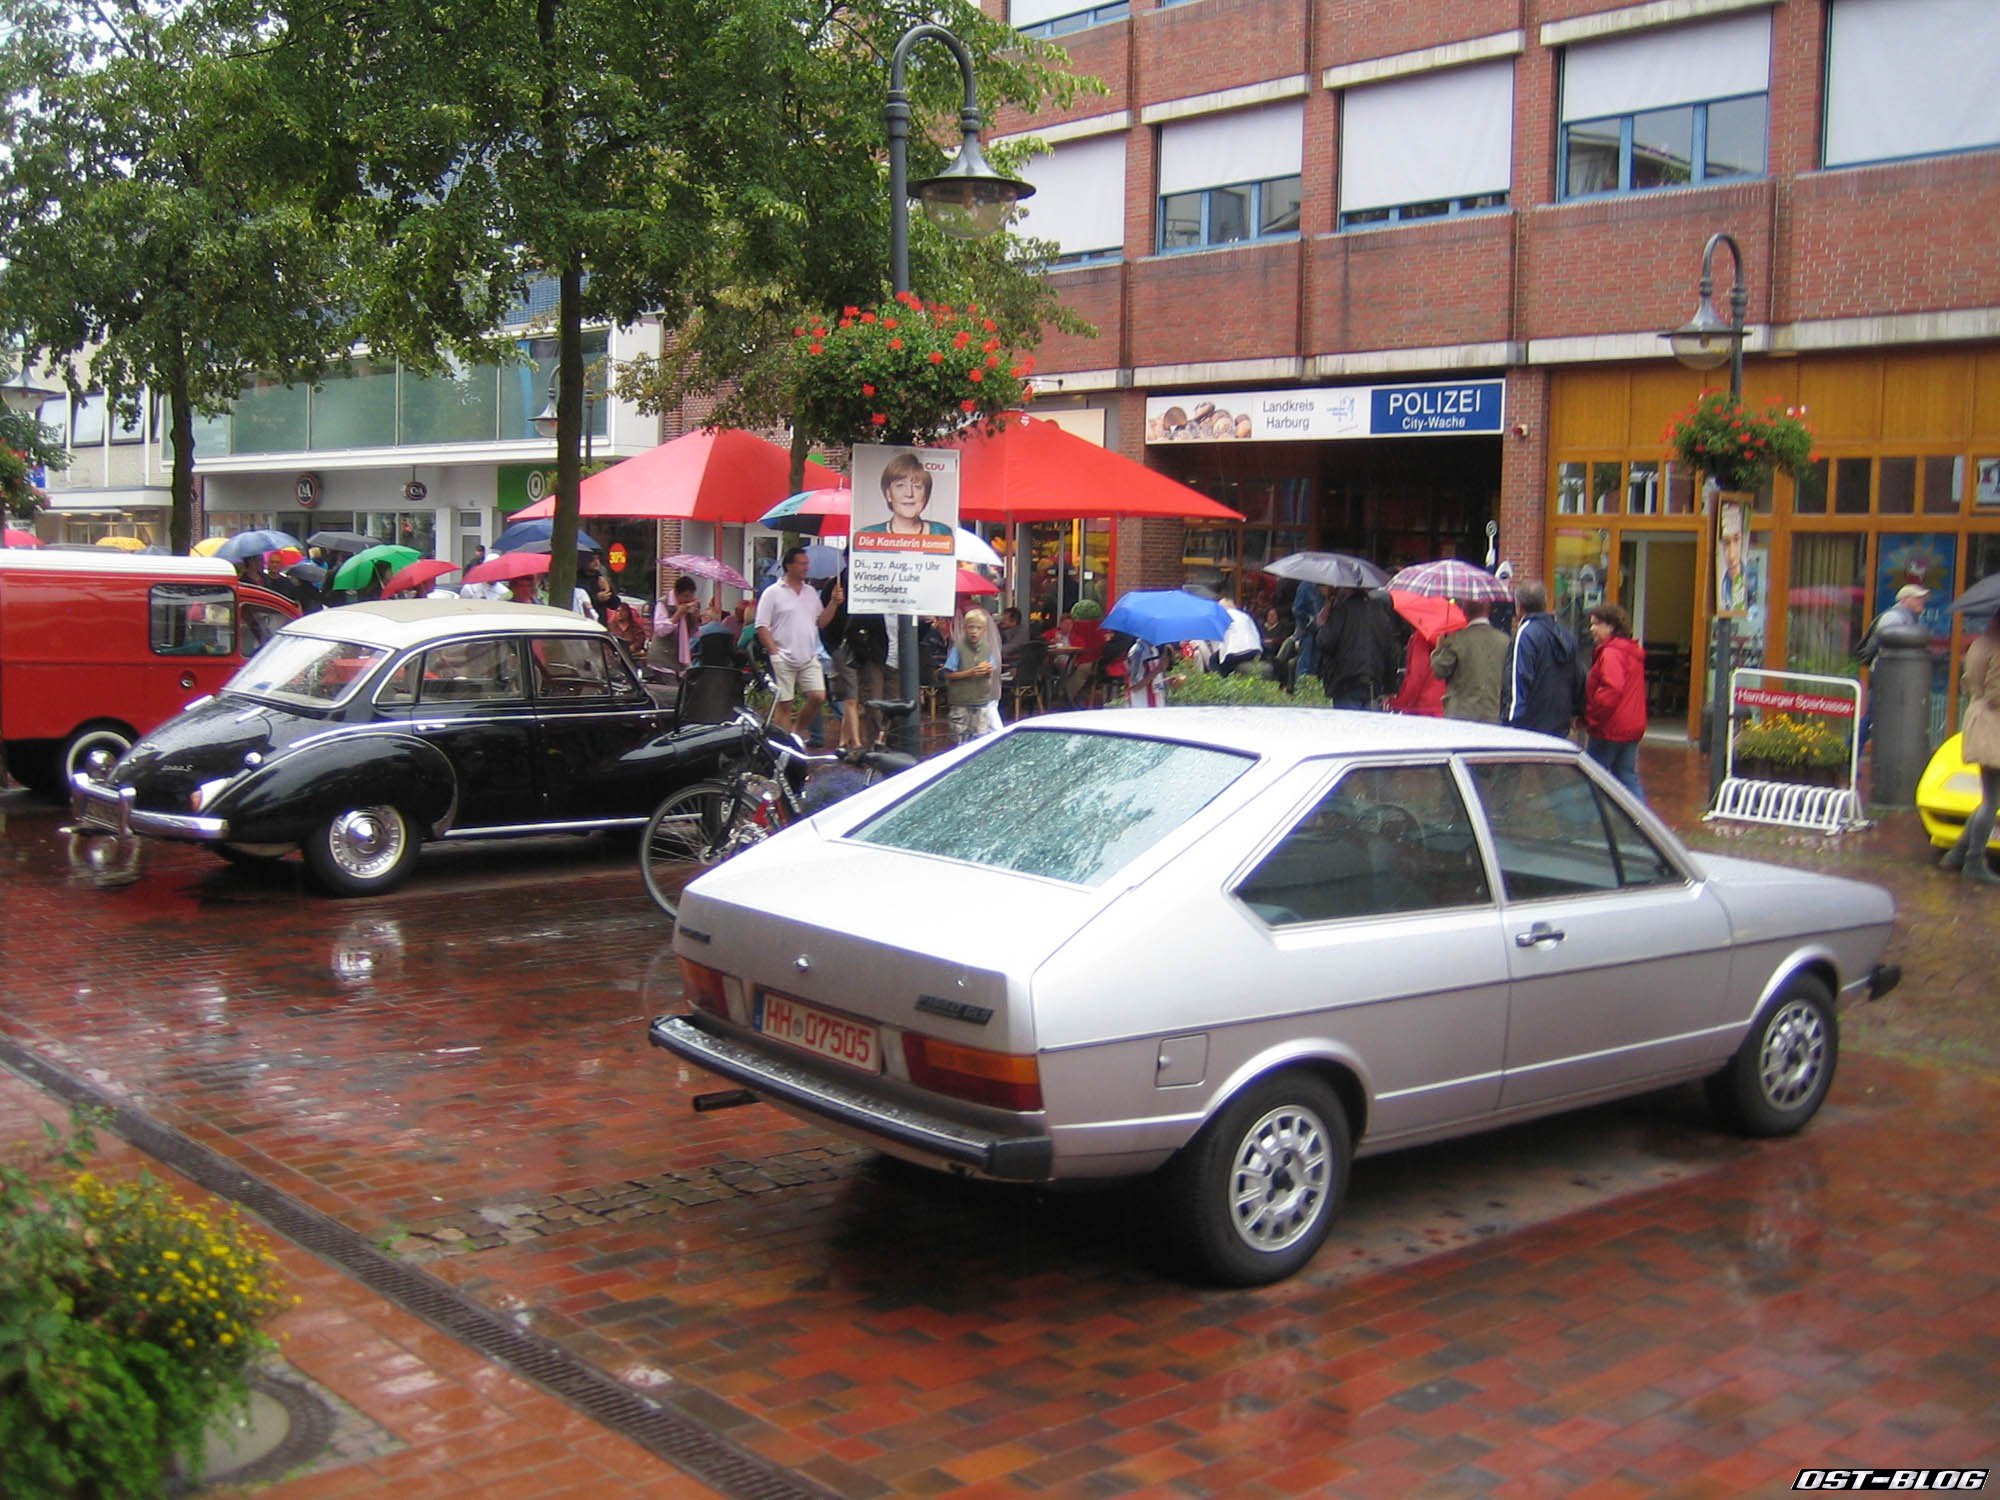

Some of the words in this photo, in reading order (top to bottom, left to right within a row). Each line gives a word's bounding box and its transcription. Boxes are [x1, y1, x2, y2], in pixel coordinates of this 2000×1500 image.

[1262, 398, 1315, 413] Landkreis
[1389, 389, 1480, 416] POLIZEI
[1266, 416, 1310, 431] Harburg
[1401, 415, 1466, 432] City-Wache
[924, 462, 945, 471] CDU
[859, 535, 875, 547] Die
[876, 536, 920, 548] Kanzlerin
[922, 540, 951, 550] kommt
[925, 561, 940, 571] Uhr
[854, 571, 889, 581] Winsen
[898, 573, 920, 583] Luhe
[853, 584, 908, 595] Schloßplatz
[1738, 688, 1795, 710] Hamburger
[1795, 694, 1852, 713] Sparkasse
[766, 999, 792, 1038] HH
[805, 1011, 871, 1063] 07505
